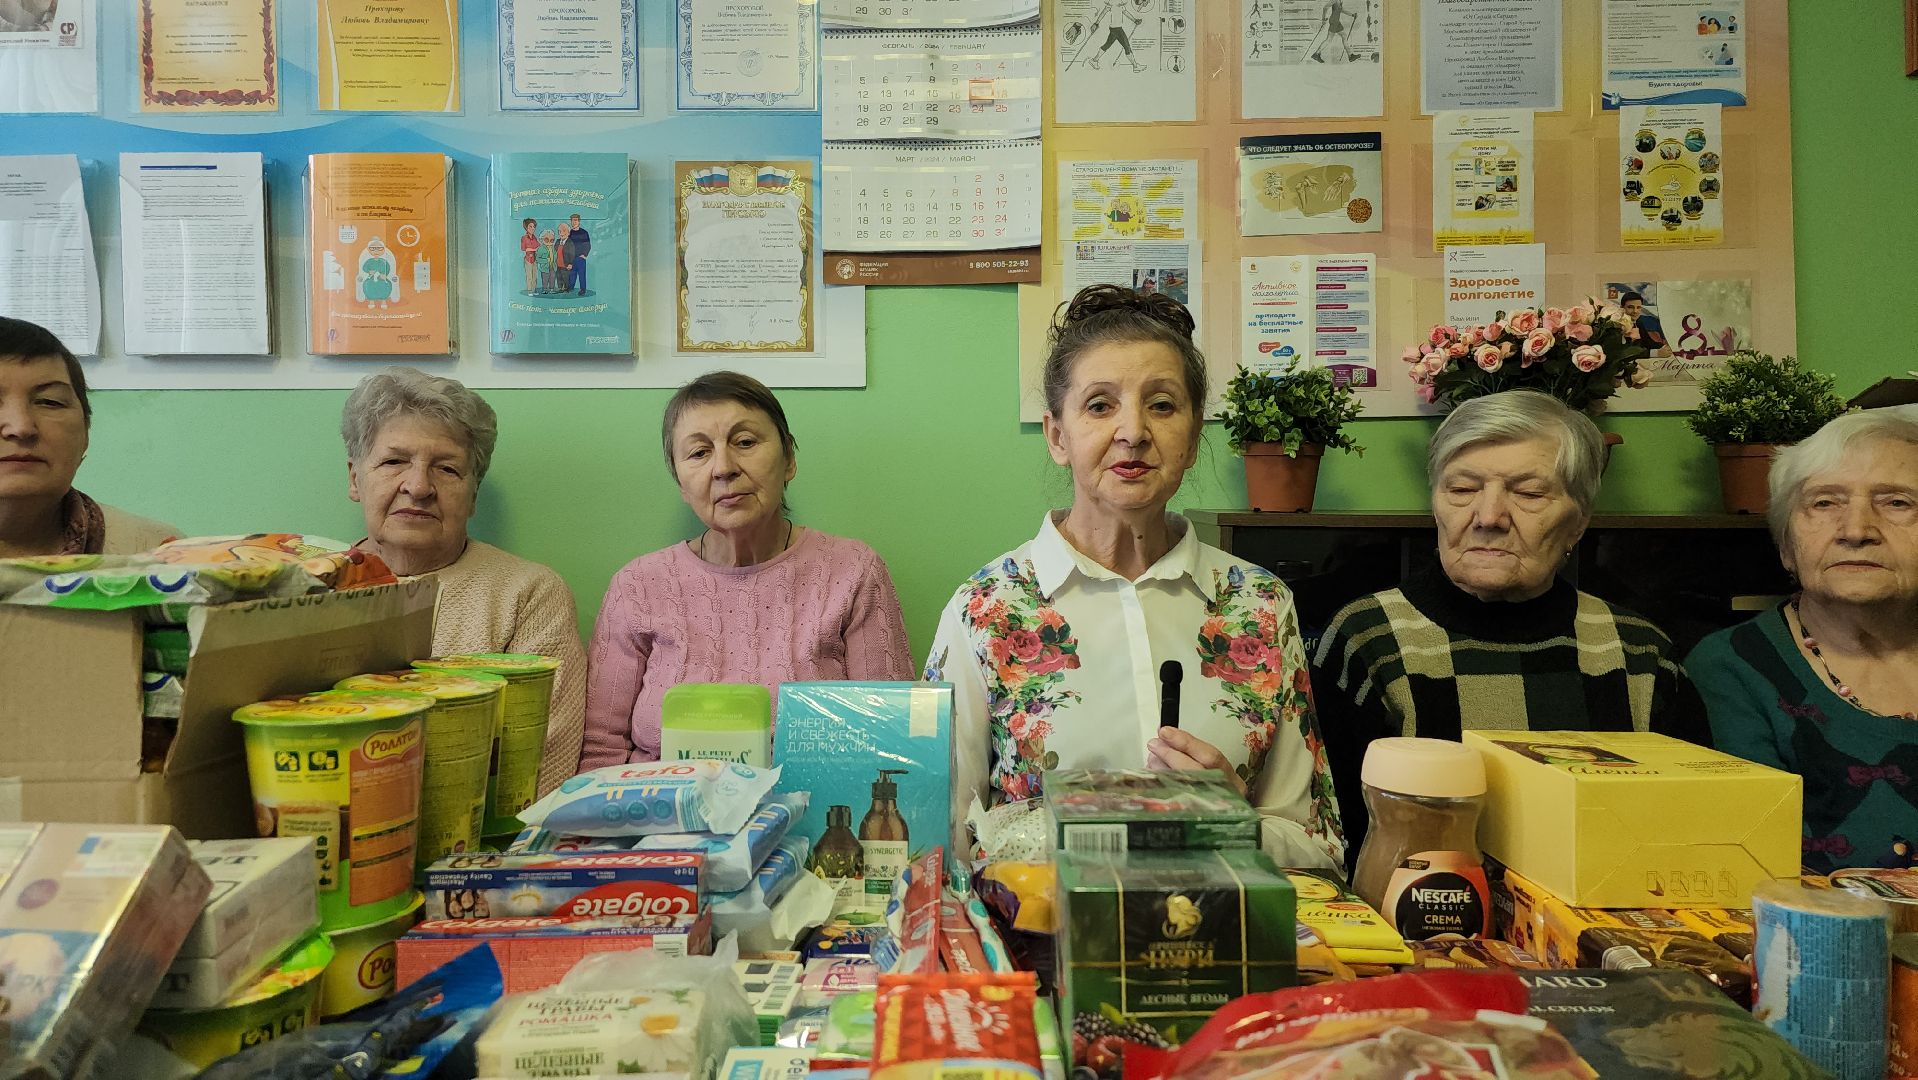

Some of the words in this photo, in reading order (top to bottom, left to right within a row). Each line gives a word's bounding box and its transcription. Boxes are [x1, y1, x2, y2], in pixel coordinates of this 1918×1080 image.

[858, 90, 869, 99] 12
[880, 89, 892, 98] 13
[903, 89, 915, 97] 14
[858, 104, 869, 113] 19
[879, 103, 893, 112] 20
[902, 103, 914, 111] 21
[926, 104, 939, 112] 22
[971, 104, 984, 113] 24
[856, 118, 869, 127] 26
[879, 117, 892, 126] 27
[926, 116, 939, 125] 29
[1248, 145, 1262, 153] ЧТО
[1263, 144, 1292, 153] СЛЕДУЕТ
[1293, 144, 1314, 152] ЗНАТЬ
[1324, 142, 1375, 151] ОСТЕОПОРОЗЕ?
[975, 175, 982, 183] 2
[998, 173, 1005, 182] 3
[859, 189, 866, 198] 4
[906, 189, 913, 198] 6
[996, 187, 1008, 195] 10
[857, 203, 868, 212] 11
[880, 203, 892, 212] 12
[926, 203, 939, 211] 14
[950, 202, 961, 211] 15
[973, 202, 984, 211] 16
[995, 200, 1007, 209] 17
[858, 217, 869, 225] 18
[880, 217, 892, 225] 19
[902, 216, 916, 225] 20
[926, 216, 938, 225] 21
[948, 216, 961, 224] 22
[995, 214, 1008, 223] 24
[856, 230, 869, 239] 25
[902, 230, 915, 238] 27
[972, 229, 985, 238] 30
[995, 228, 1006, 237] 31
[1449, 277, 1520, 289] Здоровое
[1449, 289, 1535, 301] долголетие
[1258, 319, 1304, 327] бесплатные
[1678, 313, 1708, 354] 8
[1653, 360, 1715, 379] Марта
[788, 717, 847, 728] ЭНЕРГИЯ
[788, 731, 798, 740] И
[800, 729, 870, 740] СВЕЖЕСТЬ
[786, 741, 814, 753] ДЛЯ
[818, 740, 876, 753] МУЖЧИН
[870, 847, 904, 855] SYNERGETIC
[560, 853, 695, 866] Colgate
[430, 873, 469, 881] Protection
[469, 873, 494, 881] Cavity
[430, 879, 466, 887] Maximum
[1411, 885, 1472, 904] NESCAFÉ
[573, 891, 691, 917] Colgate
[1418, 903, 1466, 912] CLASSIC
[421, 918, 563, 930] Colgate
[1424, 914, 1463, 926] CREMA
[518, 1012, 613, 1026] РОМАШКА
